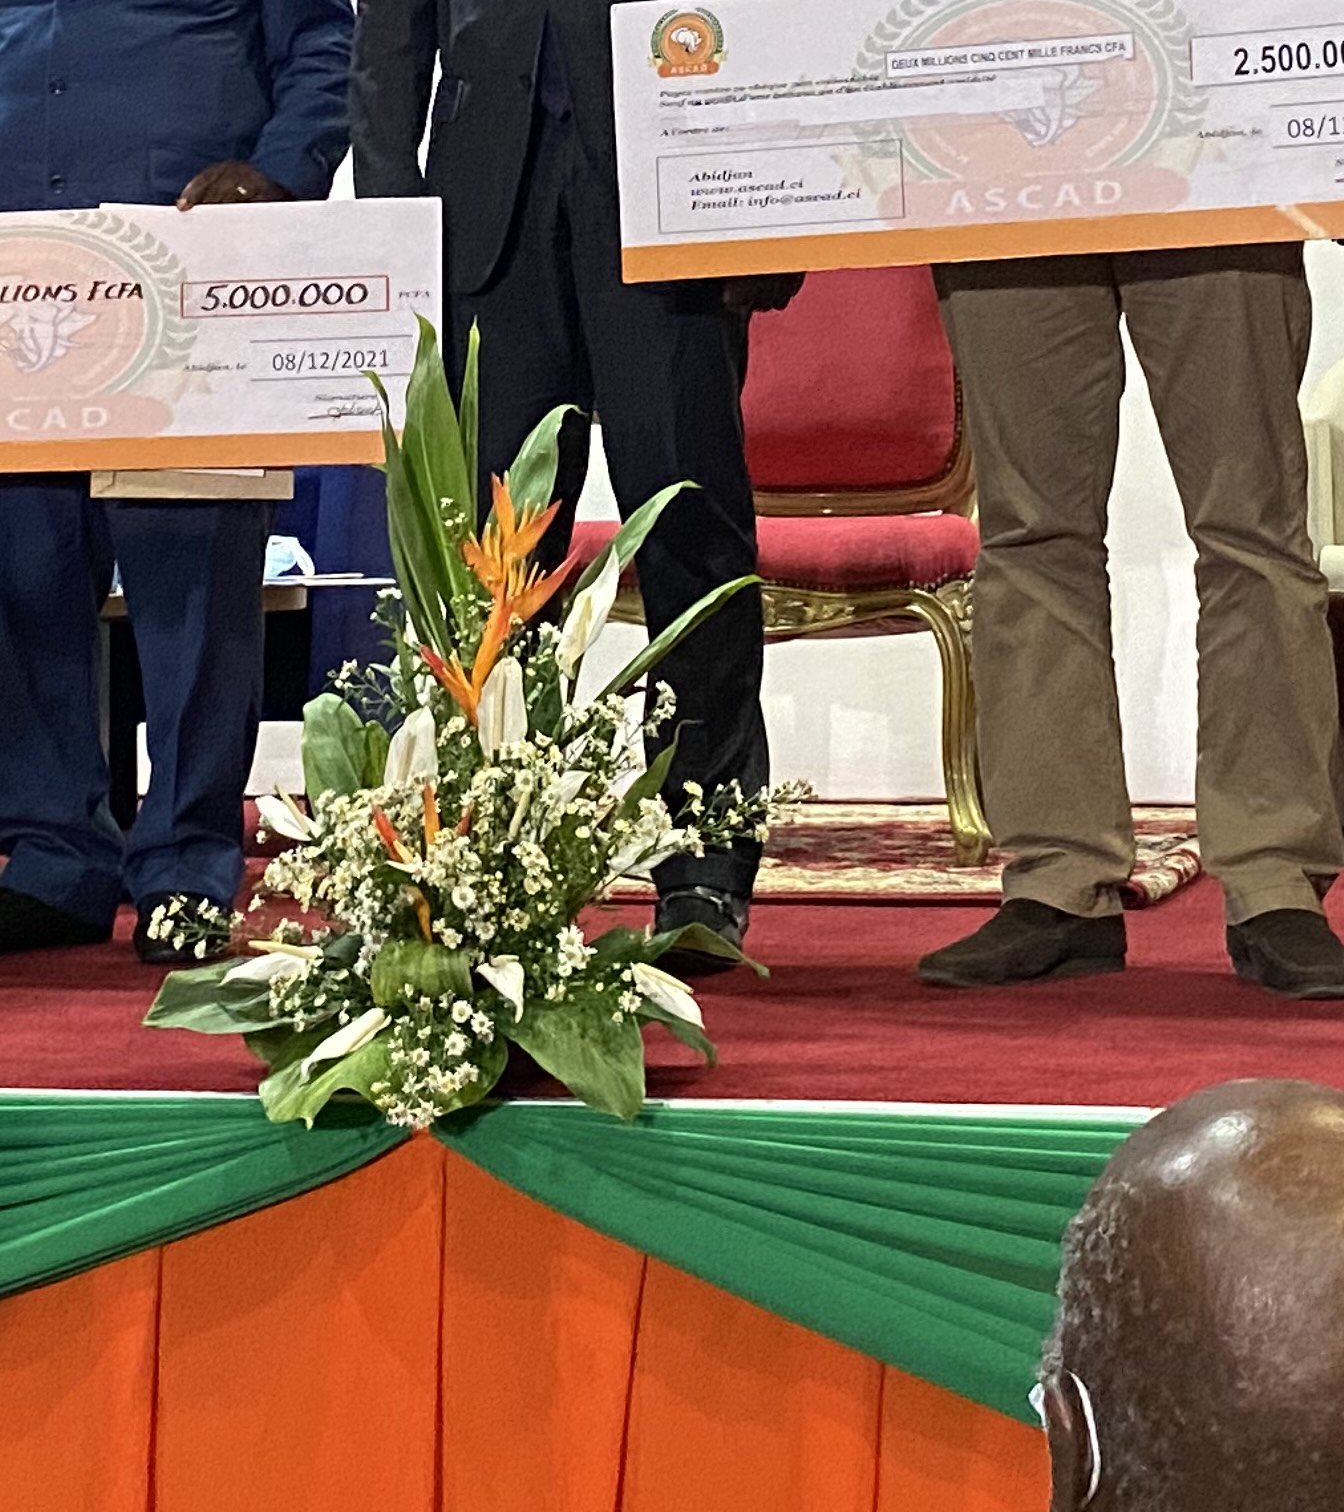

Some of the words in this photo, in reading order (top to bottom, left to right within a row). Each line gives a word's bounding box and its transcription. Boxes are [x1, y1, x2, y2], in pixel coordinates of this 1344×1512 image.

[921, 54, 968, 67] MILLIONS
[970, 52, 996, 64] CINQ
[998, 49, 1024, 62] CENT
[1027, 47, 1058, 59] MILLE
[1060, 44, 1103, 57] FRANCS
[1105, 41, 1127, 53] CFA
[688, 170, 753, 183] Abidjan
[691, 178, 804, 197] www.ascad.ci
[691, 197, 744, 211] Email:
[747, 188, 861, 208] info@ascad.ci
[946, 181, 1123, 215] ASCAD
[87, 280, 144, 302] FCFA
[200, 282, 370, 312] 5.000.000
[272, 349, 389, 374] 08/12/2021
